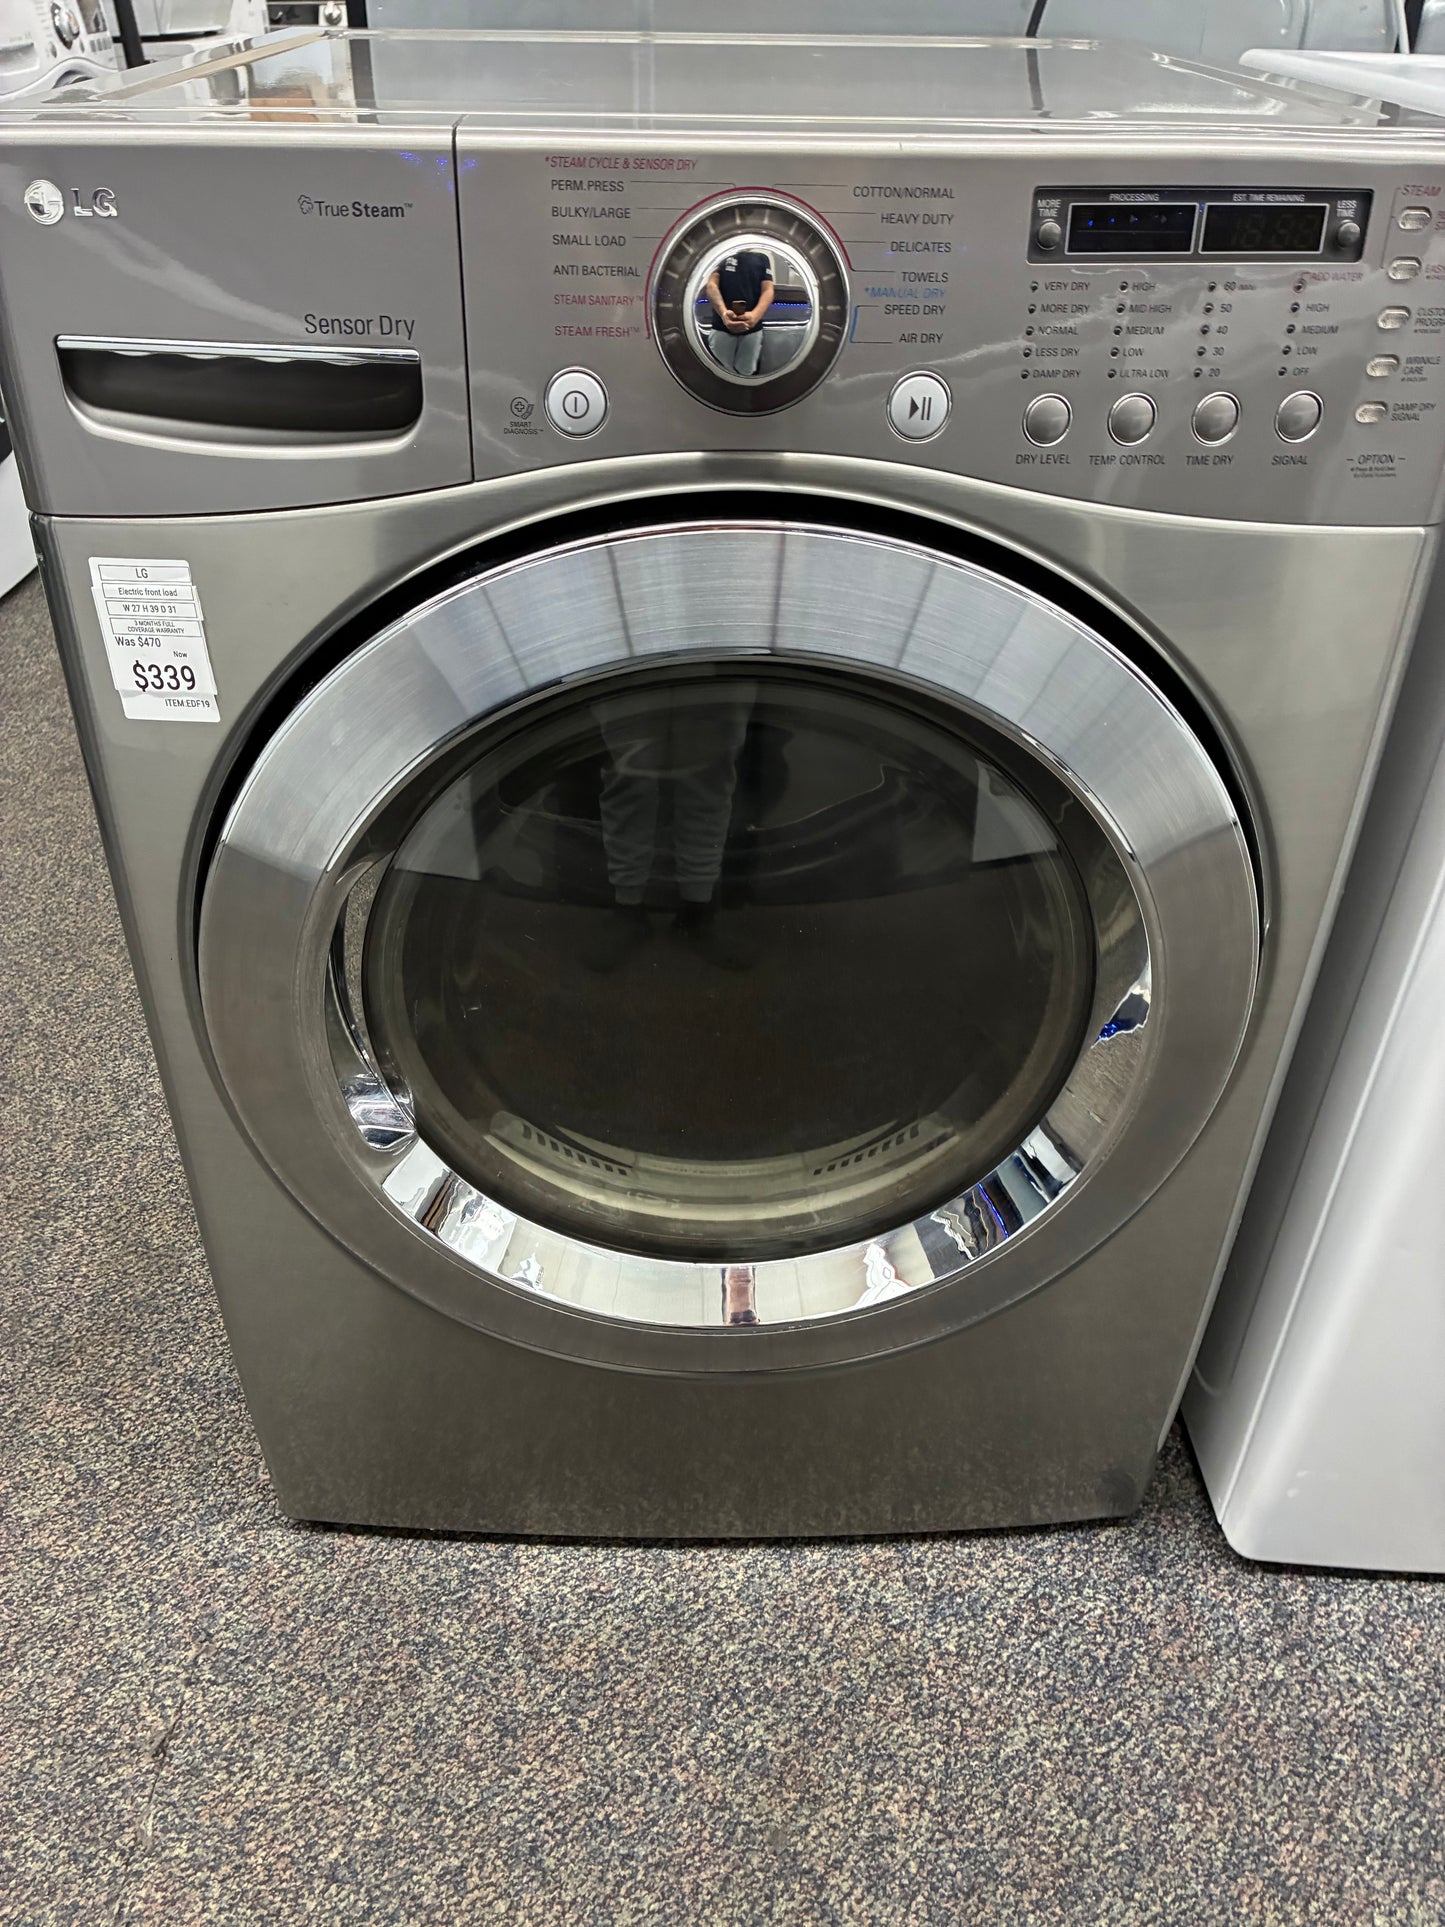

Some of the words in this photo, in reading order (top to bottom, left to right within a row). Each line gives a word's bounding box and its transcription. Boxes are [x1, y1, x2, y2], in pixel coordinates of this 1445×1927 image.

[588, 157, 619, 169] CYCLE
[622, 158, 630, 169] &
[632, 158, 675, 170] SENSOR
[676, 159, 698, 171] DRY
[853, 186, 956, 199] COTTON/NORMAL
[1401, 185, 1441, 196] STEAM
[70, 187, 118, 217] LG
[1109, 193, 1160, 202] PROCESSING
[1249, 193, 1265, 202] TIME
[1266, 194, 1305, 202] REMAINING
[1037, 199, 1061, 208] MORE
[1337, 200, 1357, 209] LESS
[551, 206, 631, 219] BULKY/LARGE
[1038, 208, 1059, 217] TIME
[1336, 208, 1356, 218] TIME
[880, 213, 919, 225] HEAVY
[922, 213, 954, 225] DUTY
[552, 234, 591, 247] SMALL
[594, 235, 626, 247] LOAD
[890, 241, 952, 253] DELICATES
[553, 265, 579, 276] ANTI
[581, 265, 641, 277] BACTERIAL
[902, 271, 949, 283] TOWELS
[1044, 281, 1069, 291] VERY
[1070, 281, 1091, 291] DRY
[1132, 281, 1155, 291] HIGH
[1223, 281, 1237, 291] 60
[922, 288, 946, 299] DRY
[553, 294, 587, 306] STEAM
[884, 304, 920, 315] SPEED
[923, 304, 946, 315] DRY
[1040, 304, 1068, 313] MORE
[1070, 304, 1090, 313] DRY
[1129, 304, 1147, 313] MID
[1149, 304, 1172, 313] HIGH
[1220, 303, 1233, 313] 50
[1305, 303, 1330, 312] HIGH
[304, 313, 374, 336] Sensor
[379, 315, 416, 341] Dry
[555, 325, 590, 337] STEAM
[1037, 326, 1079, 336] NORMAL
[1126, 326, 1165, 335] MEDIUM
[1216, 325, 1229, 335] 40
[1302, 325, 1339, 334] MEDIUM
[899, 333, 918, 344] AIR
[920, 333, 943, 344] DRY
[1035, 348, 1059, 357] LESS
[1060, 348, 1080, 357] DRY
[1123, 347, 1145, 357] LOW
[1212, 347, 1225, 356] 30
[1297, 346, 1318, 356] LOW
[1032, 369, 1061, 379] DAMP
[1062, 369, 1081, 378] DRY
[1119, 369, 1147, 378] ULTRA
[1149, 369, 1170, 378] LOW
[1208, 368, 1221, 378] 20
[1292, 367, 1310, 377] OFF
[1418, 402, 1436, 412] DRY
[1015, 454, 1038, 464] DRY
[1039, 454, 1071, 465] LEVEL
[1119, 454, 1166, 465] CONTROL
[1186, 455, 1210, 466] TIME
[1212, 455, 1235, 465] DRY
[1271, 455, 1308, 466] SIGNAL
[1358, 453, 1396, 465] OPTION
[135, 568, 149, 579] LG
[118, 587, 144, 596] Electric
[145, 588, 162, 597] front
[163, 588, 178, 597] load
[122, 604, 130, 612] W
[131, 604, 141, 613] 27
[143, 605, 149, 613] H
[150, 605, 160, 613] 39
[168, 606, 177, 614] 31
[156, 627, 185, 635] WARRANTY
[115, 636, 136, 647] Was
[137, 636, 162, 648] $470
[173, 651, 188, 659] Now
[132, 659, 197, 693] $339
